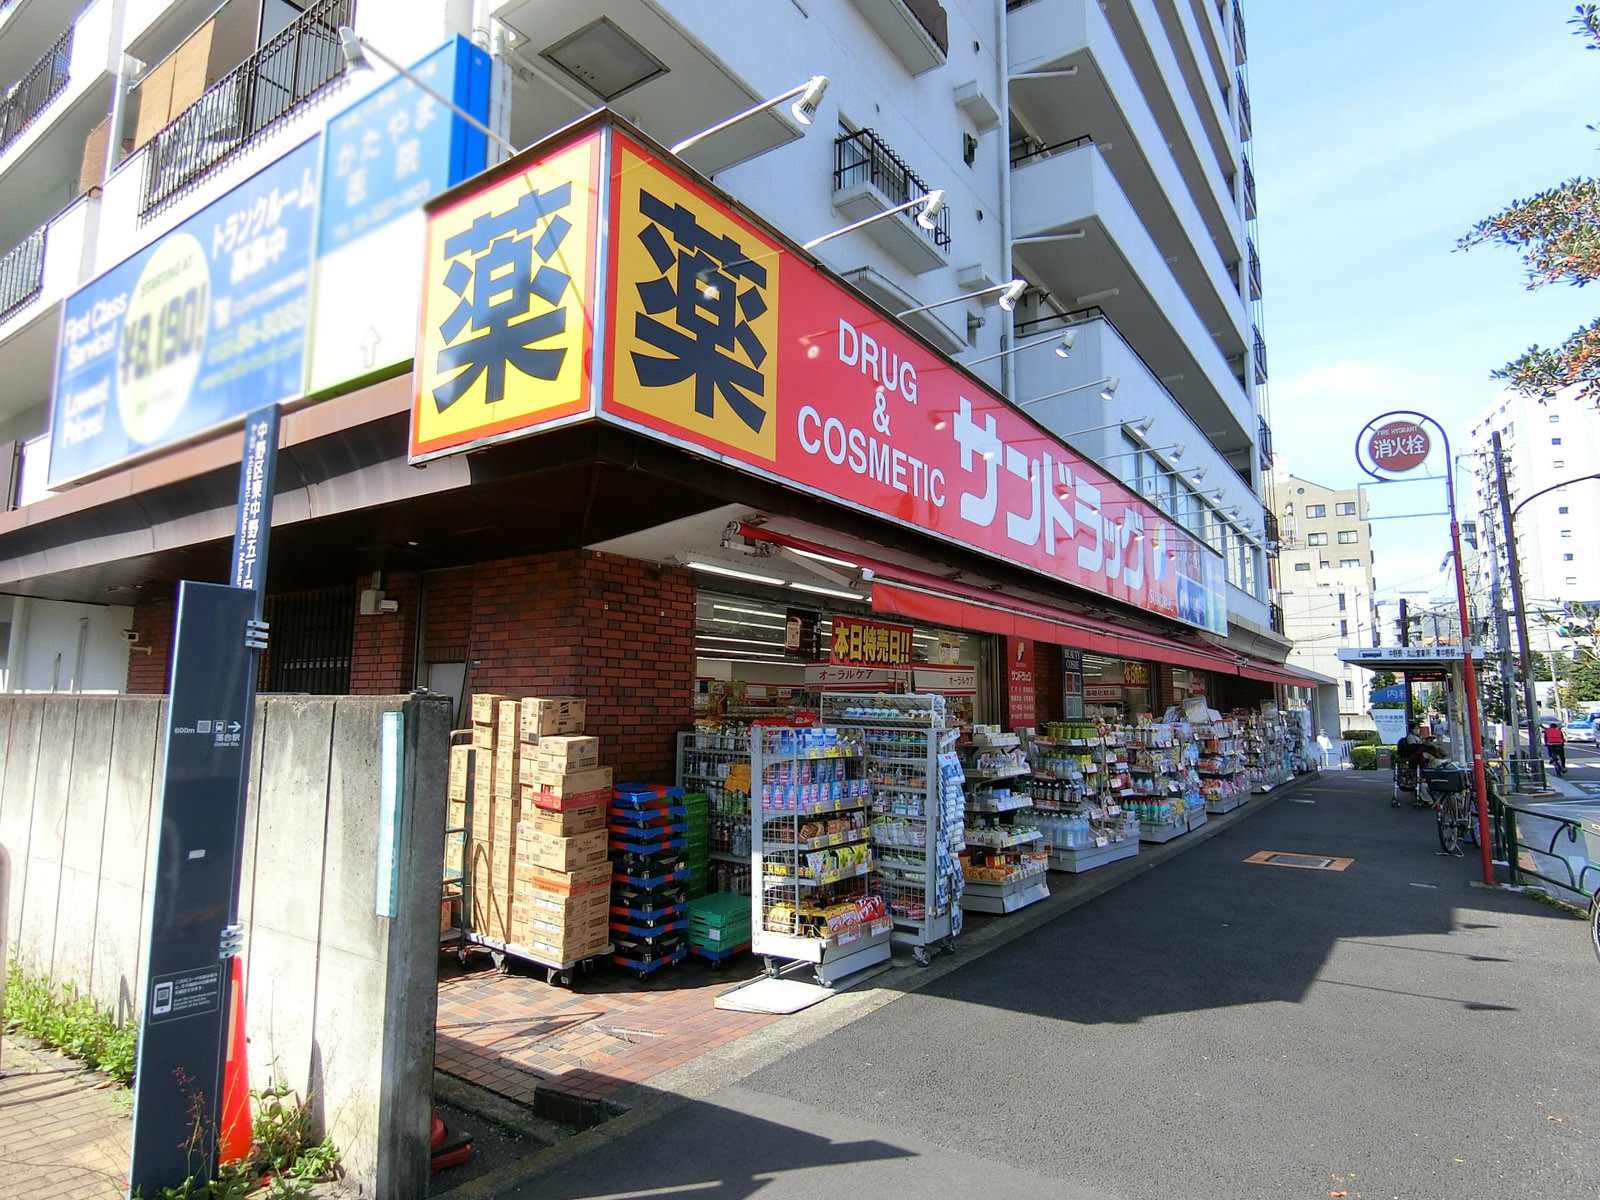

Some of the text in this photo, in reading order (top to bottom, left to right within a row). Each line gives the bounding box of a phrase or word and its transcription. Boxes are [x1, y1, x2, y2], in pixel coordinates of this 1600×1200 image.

[211, 167, 316, 260] トランクルーム
[432, 181, 572, 414] 薬
[629, 187, 769, 434] 薬
[838, 318, 918, 405] DRUG
[872, 393, 892, 437] &
[1376, 426, 1418, 436] FIRE HYDRANT
[797, 405, 947, 509] COSMETIC
[1373, 433, 1426, 459] 消火栓
[953, 396, 1145, 590] サンドラッグ
[819, 669, 875, 680] オーラルケア
[948, 676, 974, 686] オーラルケア
[1011, 670, 1032, 681] サンドラッグ
[174, 726, 195, 734] 600m
